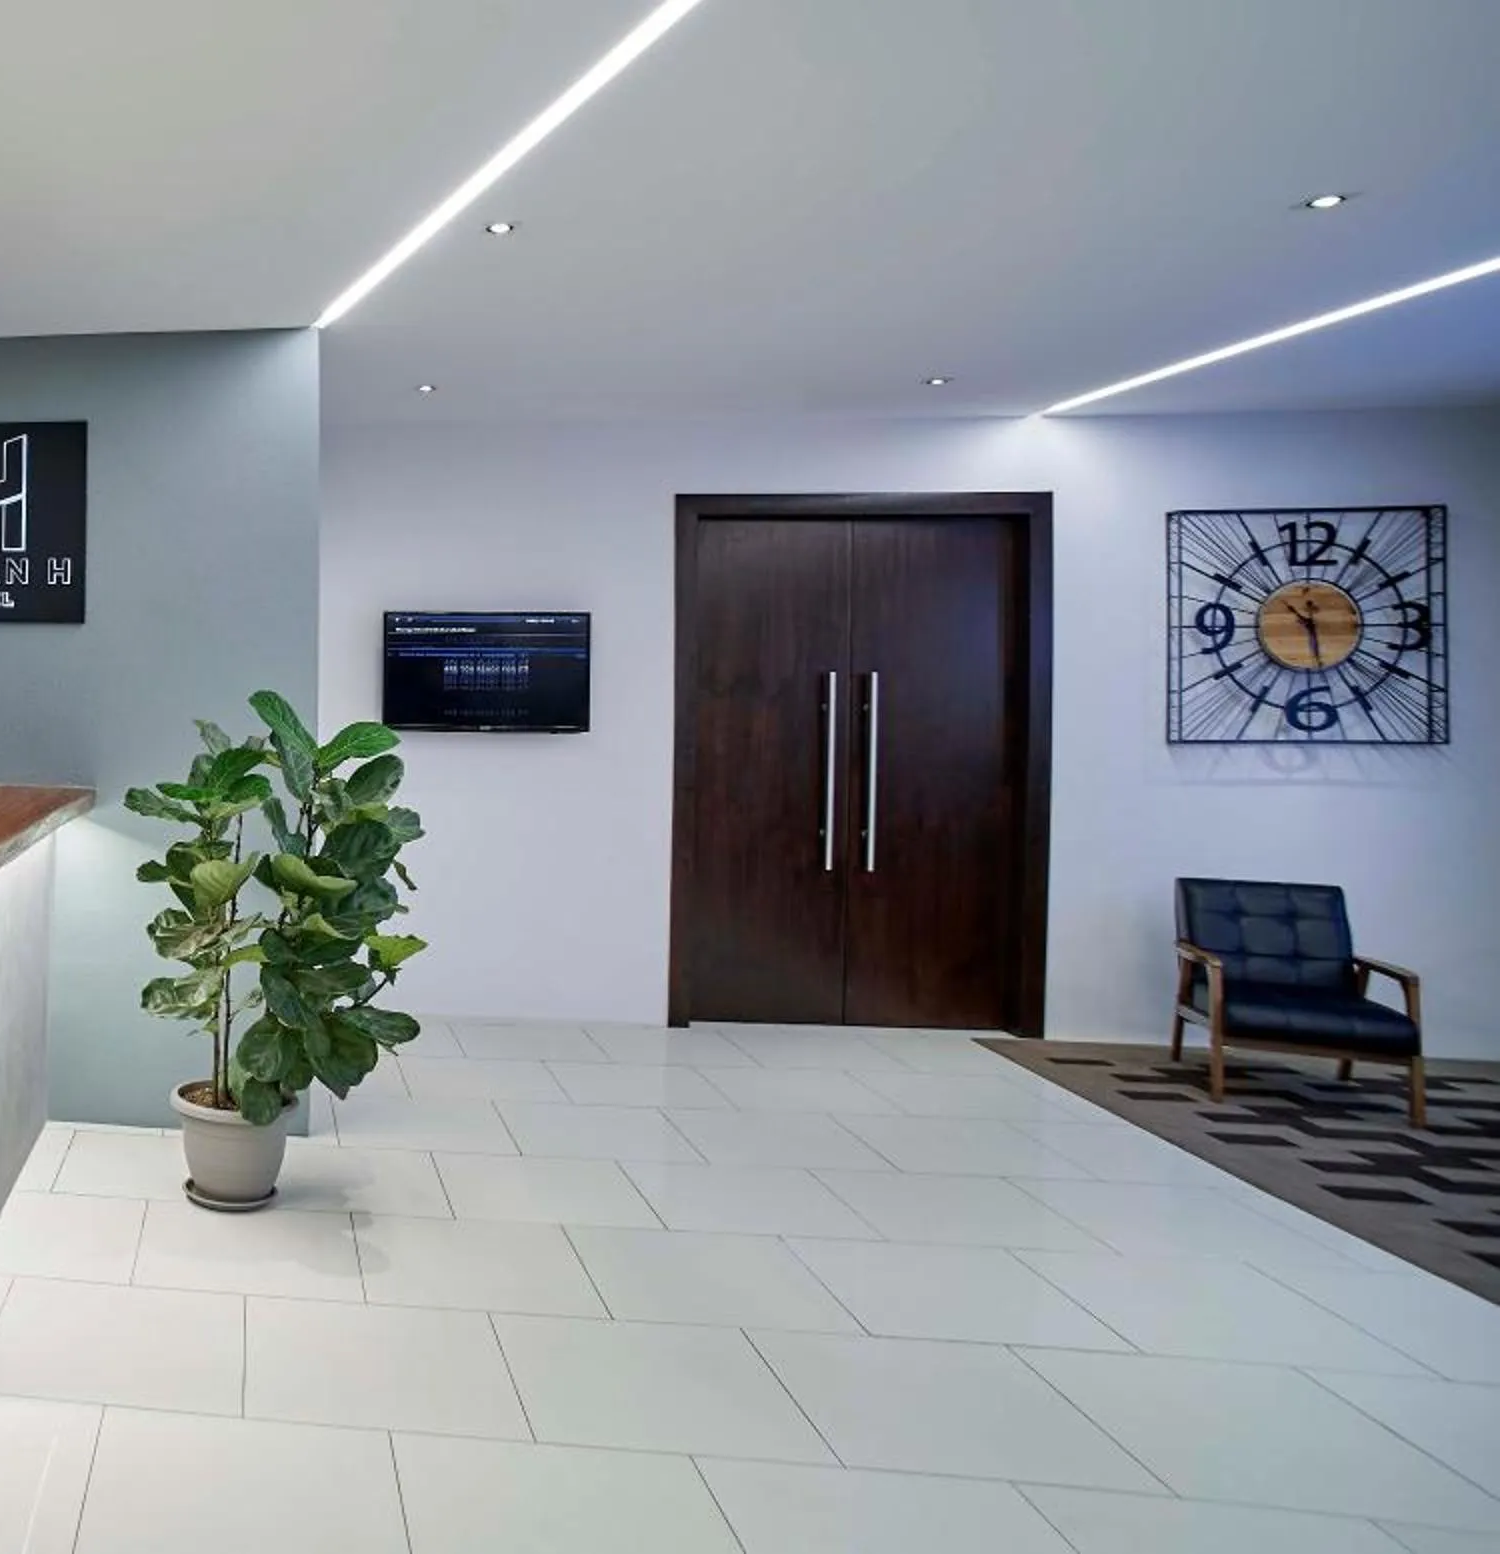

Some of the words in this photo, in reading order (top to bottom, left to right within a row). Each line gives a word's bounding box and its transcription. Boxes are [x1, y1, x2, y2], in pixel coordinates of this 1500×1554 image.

[1278, 521, 1338, 567] 12
[47, 556, 71, 585] H
[1195, 602, 1235, 654] 9
[1387, 601, 1432, 651] 3
[1284, 686, 1338, 732] 6
